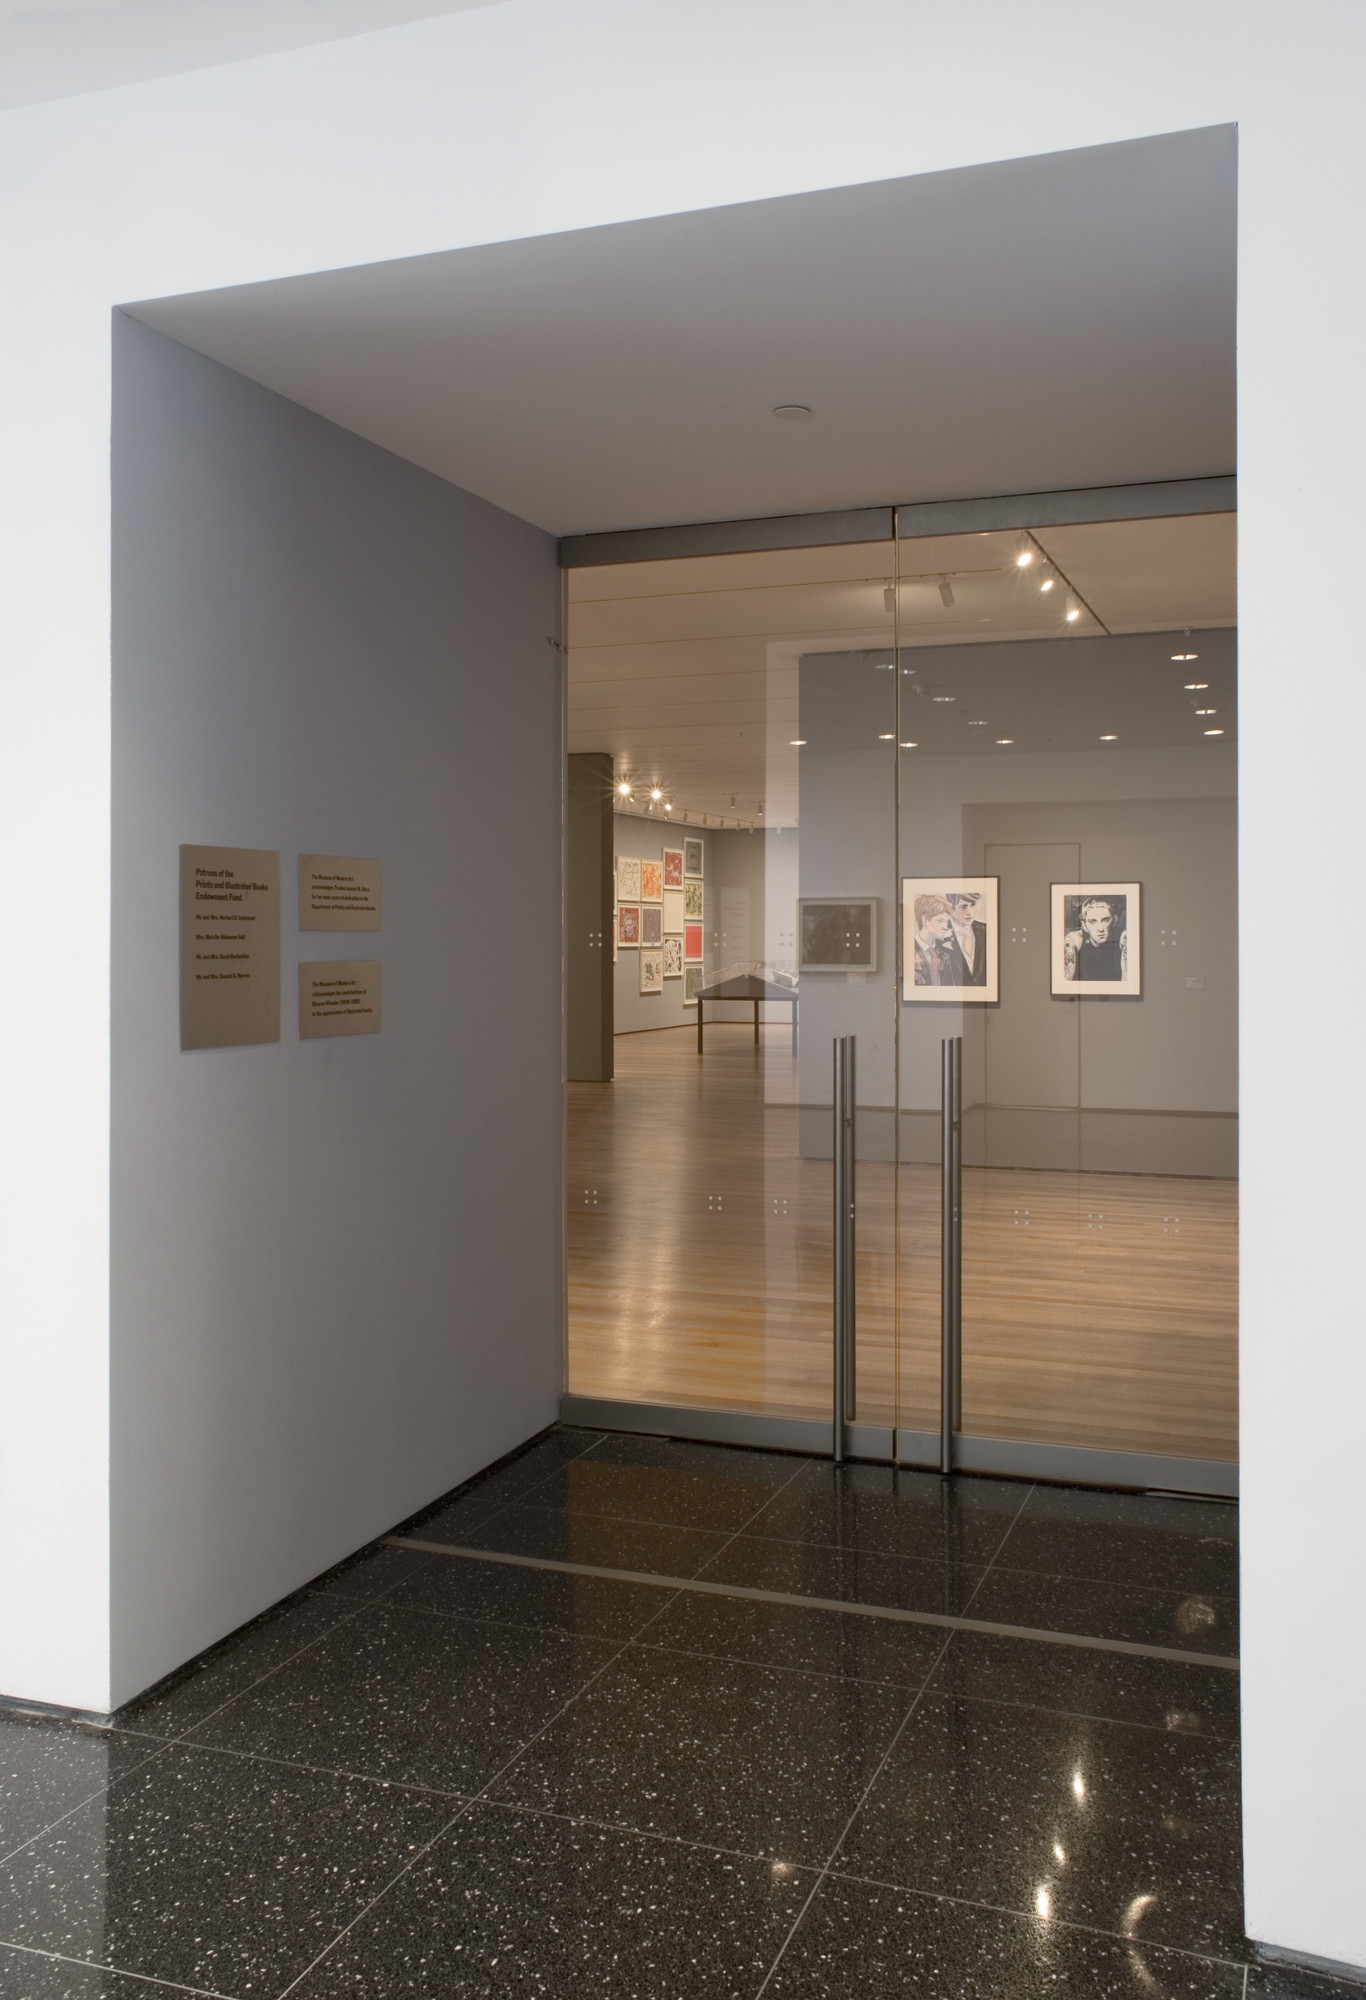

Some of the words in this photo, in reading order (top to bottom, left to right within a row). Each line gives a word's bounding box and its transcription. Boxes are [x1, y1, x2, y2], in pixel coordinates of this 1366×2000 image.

[196, 868, 217, 877] Patrons
[225, 870, 234, 878] the
[196, 880, 213, 888] Prints
[225, 882, 252, 890] Illustrated
[253, 883, 268, 891] Books
[196, 892, 228, 901] Endowment
[229, 893, 242, 901] Fund
